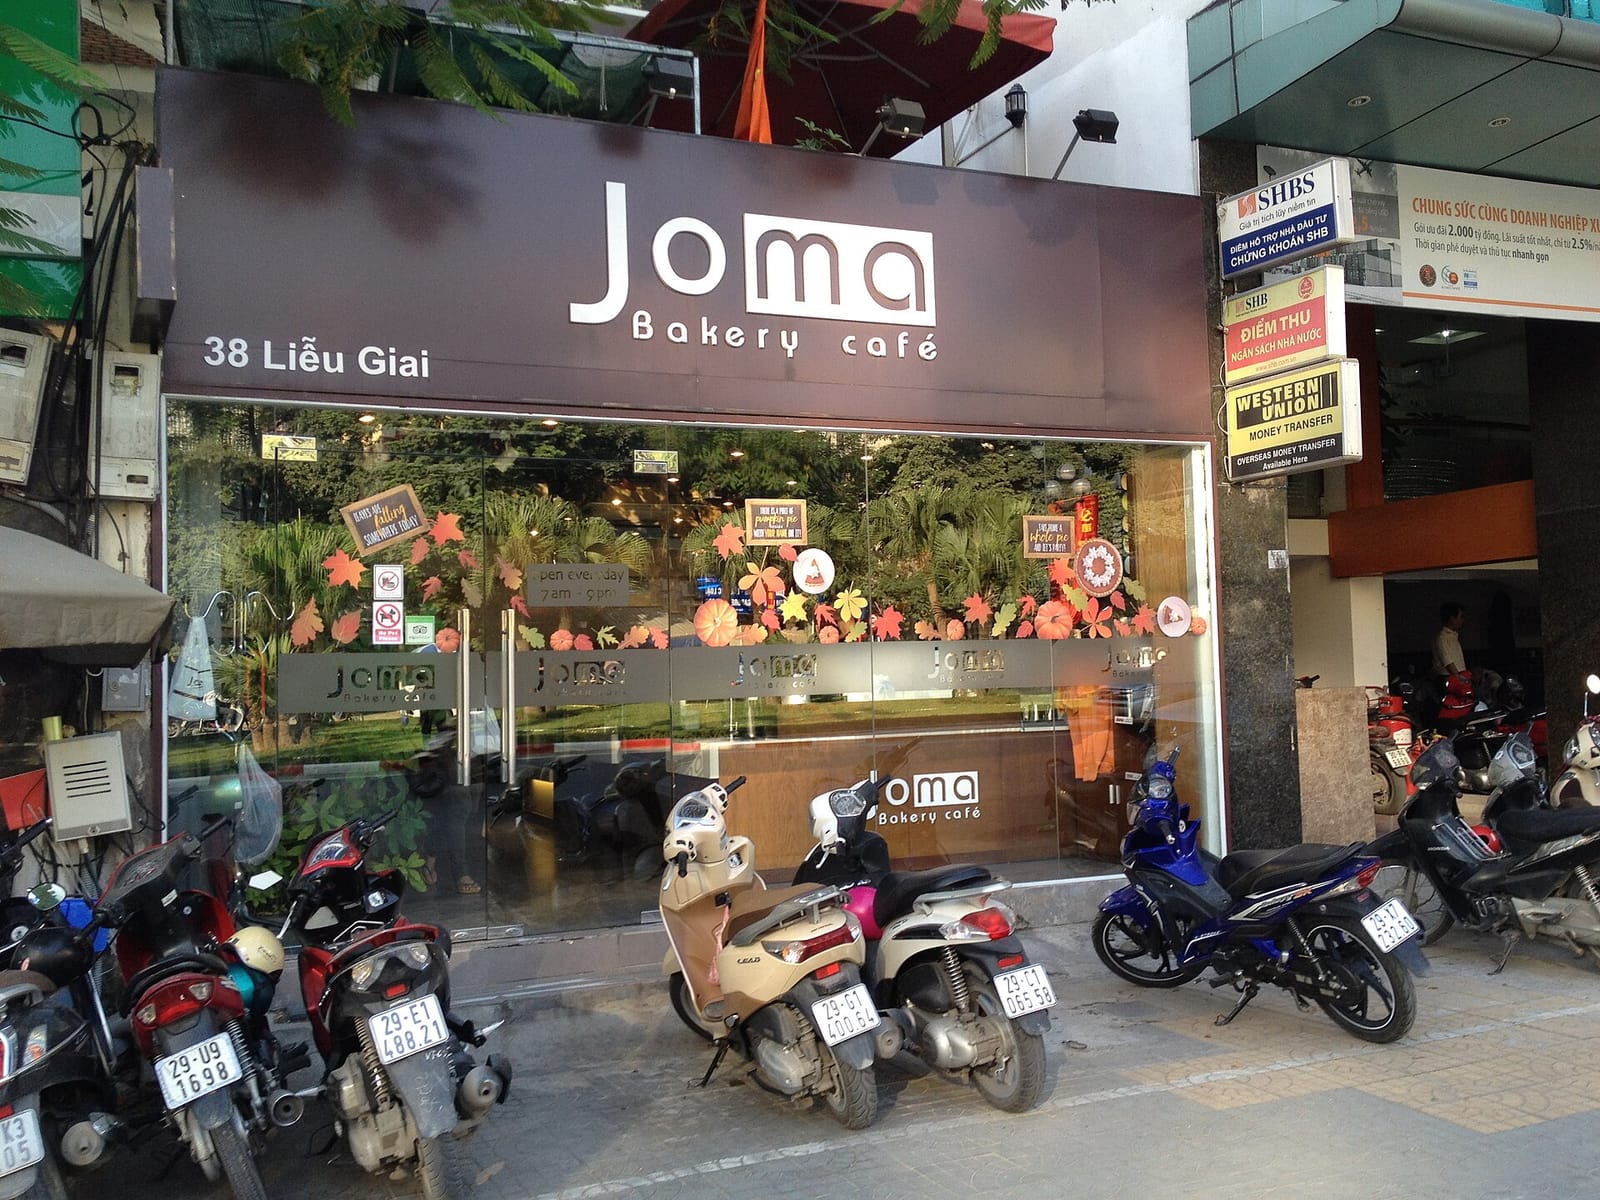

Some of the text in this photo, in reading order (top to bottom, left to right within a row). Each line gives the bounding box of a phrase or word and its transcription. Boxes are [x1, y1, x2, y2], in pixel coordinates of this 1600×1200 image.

[1258, 171, 1315, 211] SHBS
[1262, 231, 1278, 243] TRỢ
[1279, 224, 1296, 237] NHÀ
[1314, 213, 1328, 225] TƯ
[1412, 197, 1452, 216] CHUNG
[1454, 200, 1476, 219] SỨC
[1478, 203, 1507, 223] CÙNG
[1510, 208, 1548, 228] DOANH
[1550, 214, 1588, 235] NGHIỆP
[1448, 224, 1474, 238] 2.000
[569, 181, 937, 327] Joma
[1230, 226, 1329, 267] CHỨNG KHOÁN SHB
[1512, 249, 1535, 260] nhanh
[1536, 253, 1550, 264] gọn
[1245, 292, 1268, 310] SHB
[632, 310, 938, 360] Bakery café
[1241, 317, 1278, 343] ĐIỂM
[1279, 309, 1311, 331] THU
[203, 336, 430, 378] 38 Liễu Giai
[1231, 327, 1322, 363] NGÂN SÁCH NHÀ NƯỚC
[1237, 377, 1319, 412] WESTERN
[1262, 394, 1319, 421] UNION
[1249, 414, 1333, 441] MONEY TRANSFER
[1237, 438, 1336, 466] OVERSEAS MONEY TRANSFER
[1262, 455, 1308, 470] Available Here
[533, 569, 563, 582] pen
[540, 589, 571, 602] 7am
[878, 806, 982, 825] Bakery café
[381, 1000, 431, 1036] 29-E1
[827, 1011, 875, 1041] 400.64
[383, 1022, 442, 1059] 488.21
[168, 1040, 222, 1080] 29-U9
[176, 1061, 230, 1099] 1698
